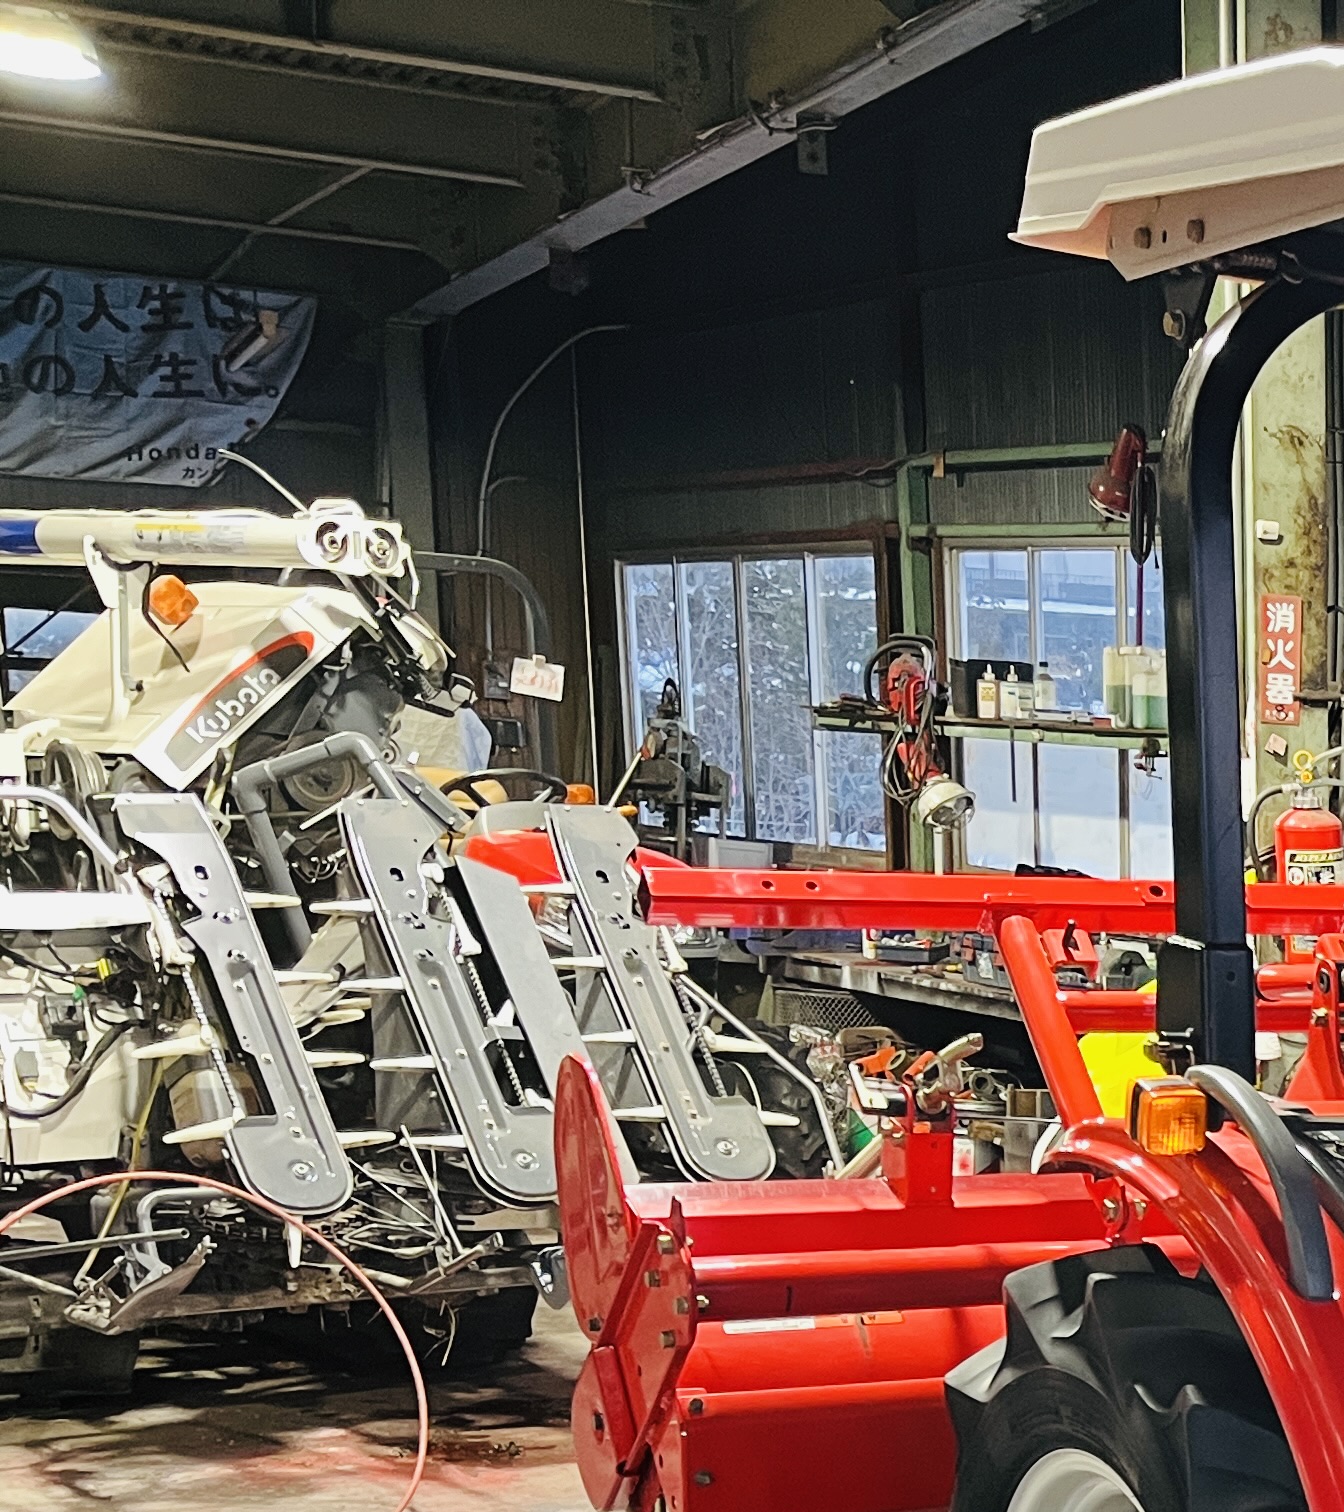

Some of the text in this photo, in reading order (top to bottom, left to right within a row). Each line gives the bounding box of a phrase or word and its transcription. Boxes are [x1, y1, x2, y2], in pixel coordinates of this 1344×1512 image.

[1266, 602, 1296, 706] 消火器
[185, 666, 282, 745] Kubota
